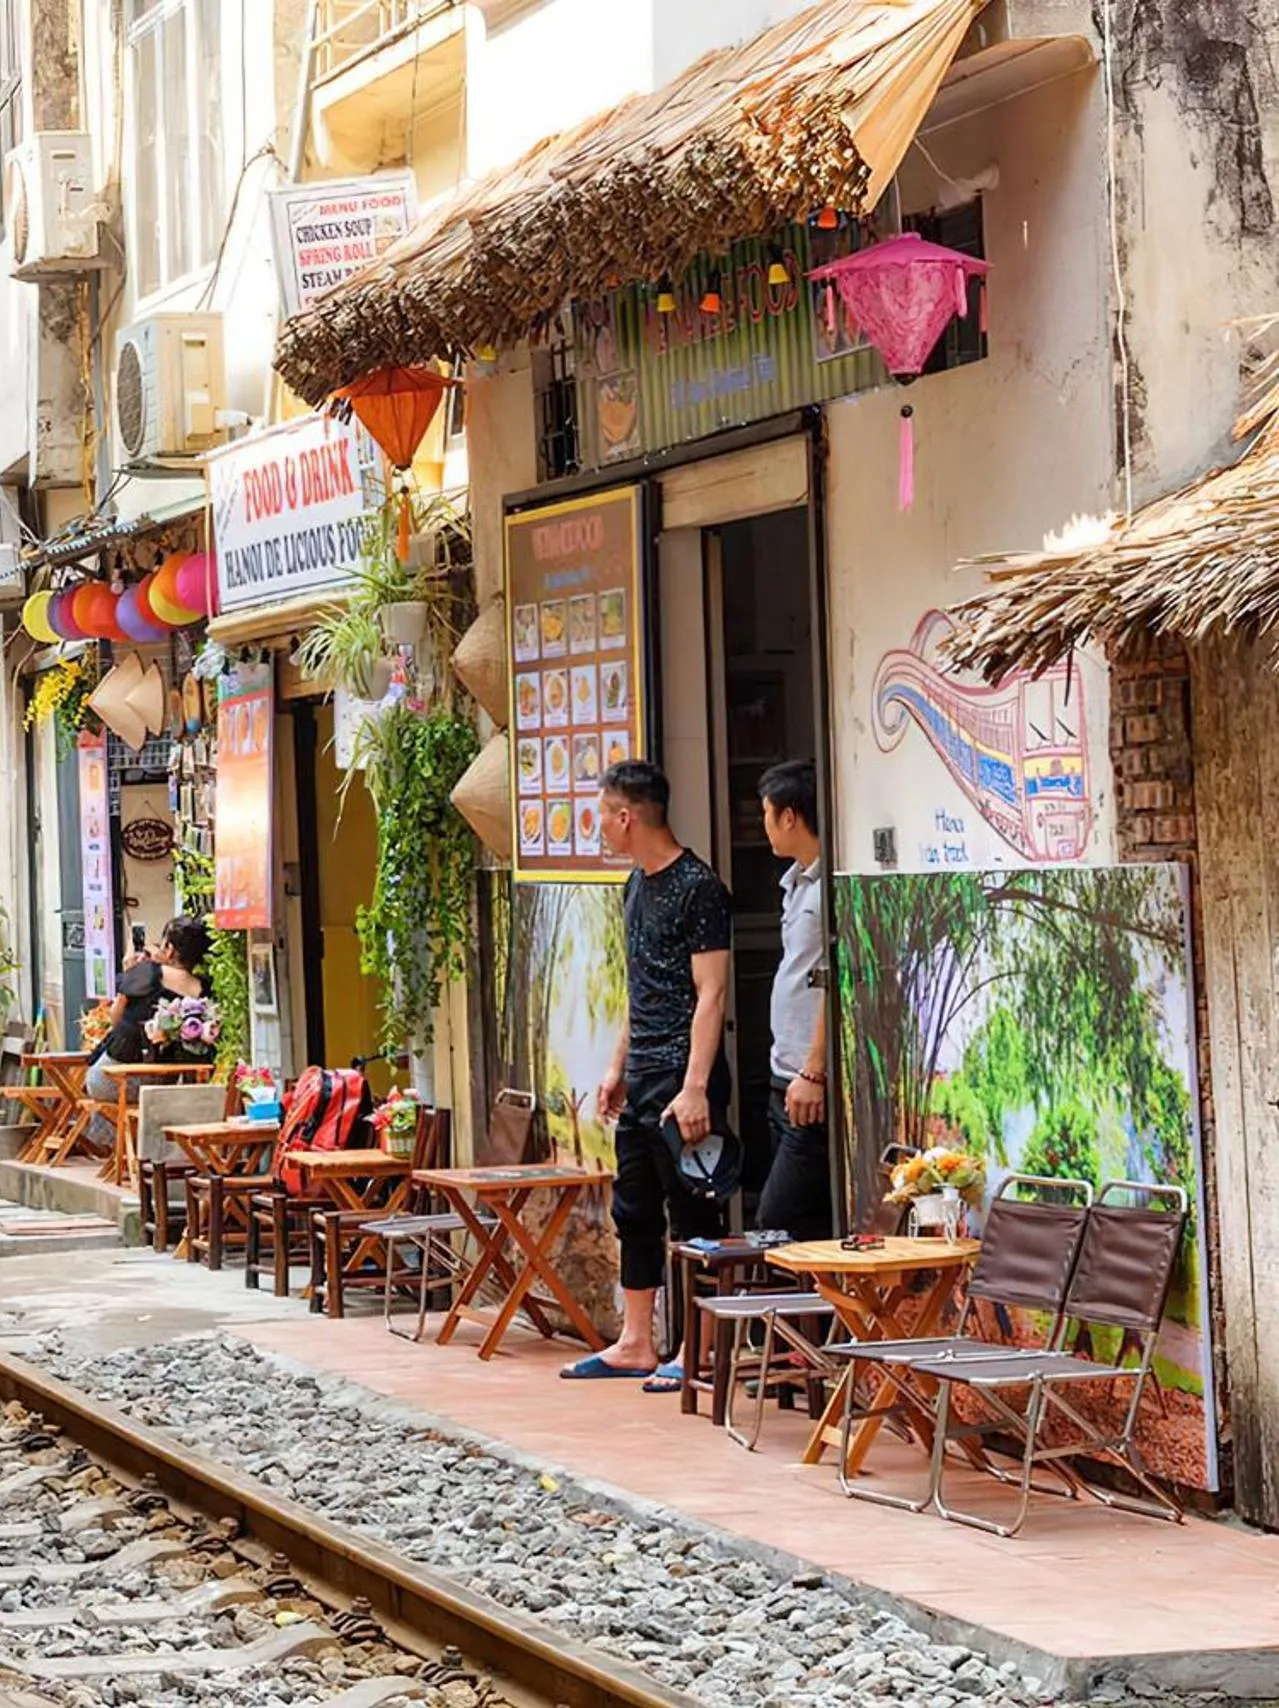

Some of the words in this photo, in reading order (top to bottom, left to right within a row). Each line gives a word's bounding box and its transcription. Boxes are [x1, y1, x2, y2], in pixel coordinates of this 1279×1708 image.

[320, 202, 358, 216] MENU
[362, 196, 401, 210] FOOD
[297, 222, 342, 243] CHICKEN
[344, 217, 371, 238] SOUP
[299, 246, 341, 266] SPRING
[344, 242, 374, 261] ROLL
[243, 461, 283, 523] FOOD
[299, 437, 354, 506] DRINK
[225, 540, 263, 589] HANOI
[337, 514, 367, 564] FOO
